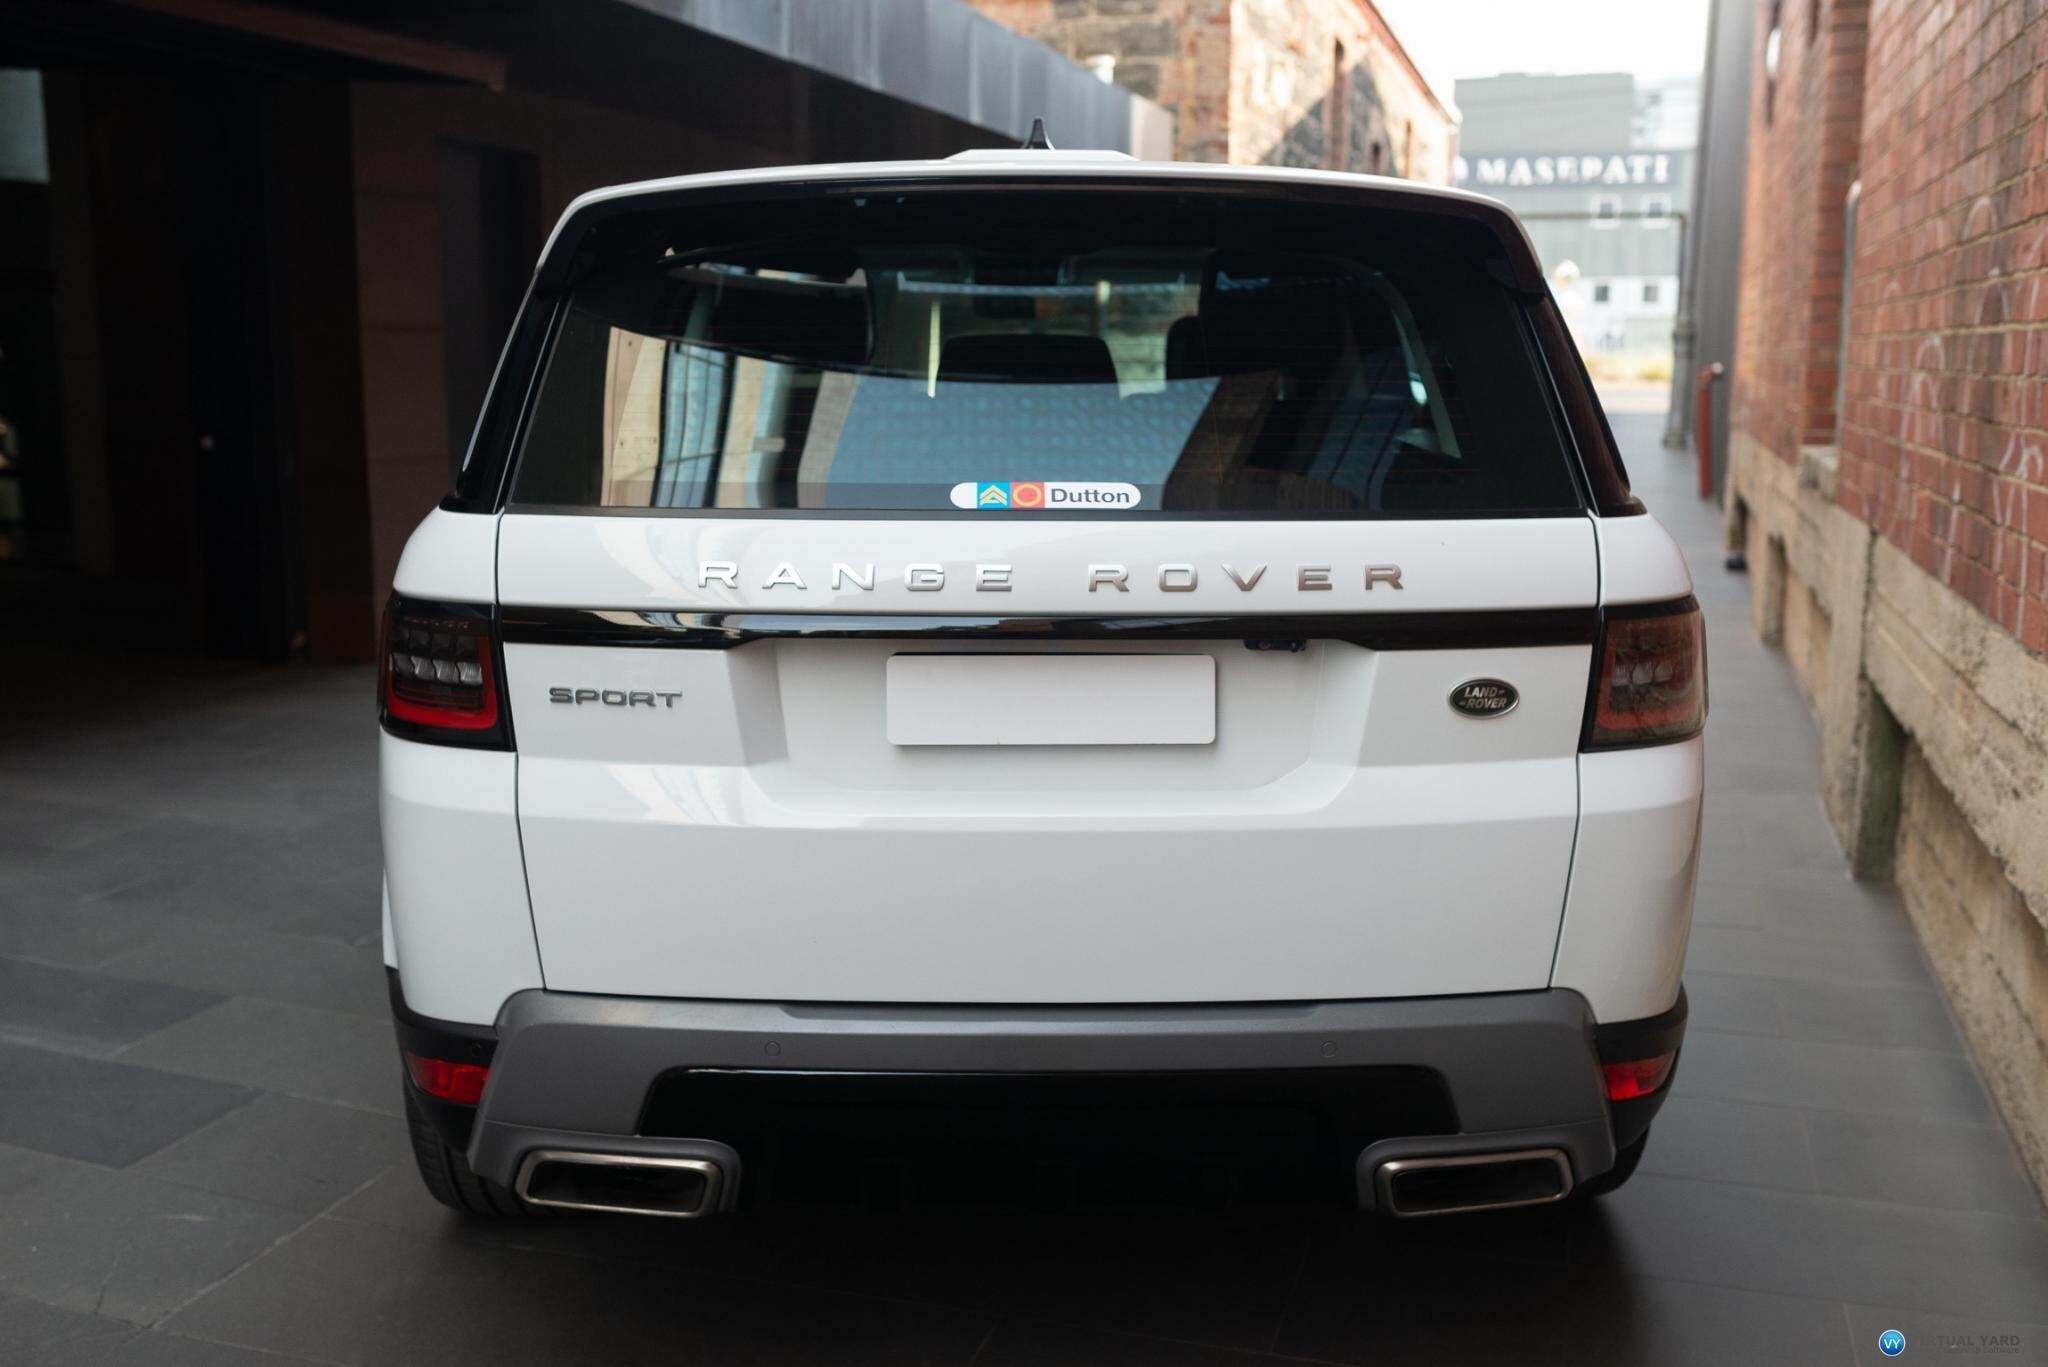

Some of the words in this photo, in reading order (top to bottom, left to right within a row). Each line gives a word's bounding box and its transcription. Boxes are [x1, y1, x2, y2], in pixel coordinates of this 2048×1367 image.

[1051, 488, 1130, 503] Dutton
[698, 560, 1013, 592] RANGE
[1088, 563, 1404, 593] ROVER
[549, 687, 683, 708] SPORT
